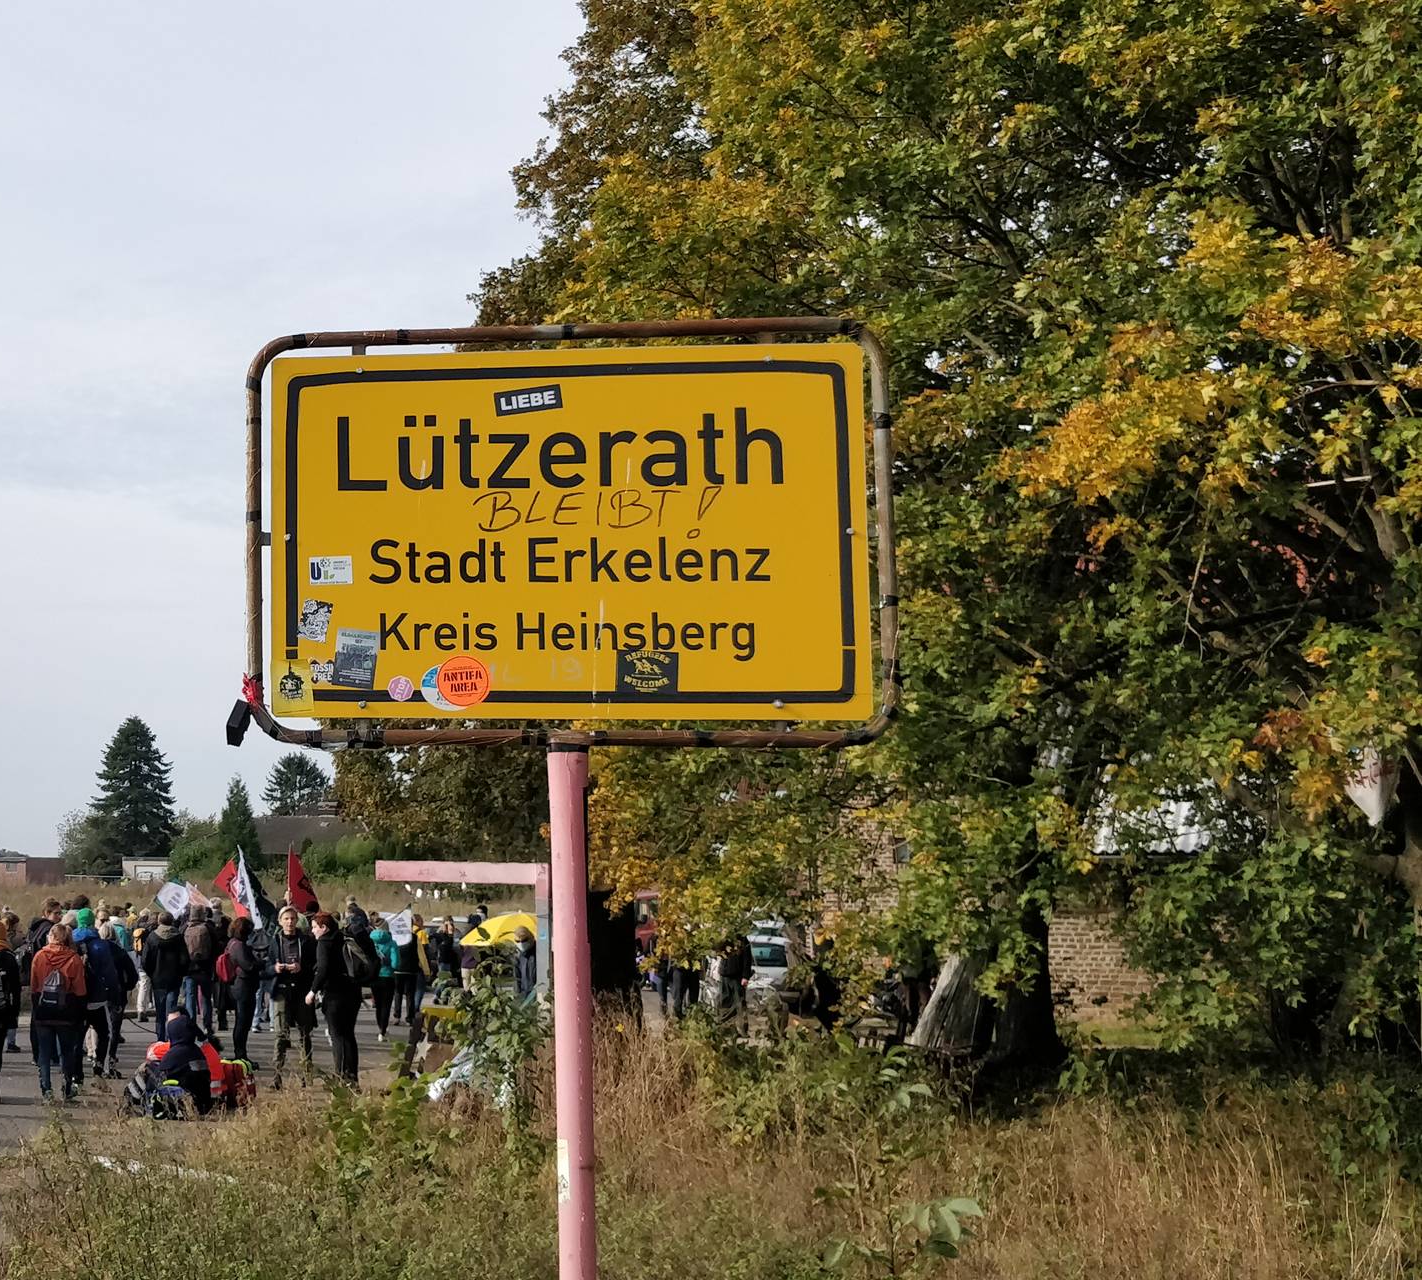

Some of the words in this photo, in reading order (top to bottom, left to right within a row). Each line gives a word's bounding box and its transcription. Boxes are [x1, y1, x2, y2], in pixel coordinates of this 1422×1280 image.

[500, 390, 556, 411] LIEBE
[337, 407, 784, 491] Lützerath
[369, 538, 506, 584] Stadt
[528, 536, 771, 583] Erkelenz
[379, 612, 498, 651] Kreis
[516, 612, 756, 662] Heinsberg
[624, 651, 671, 664] REFUGEES
[314, 672, 333, 681] FREE
[443, 670, 483, 682] ANTIFA
[624, 675, 670, 688] WELCOME
[450, 682, 478, 693] AREA
